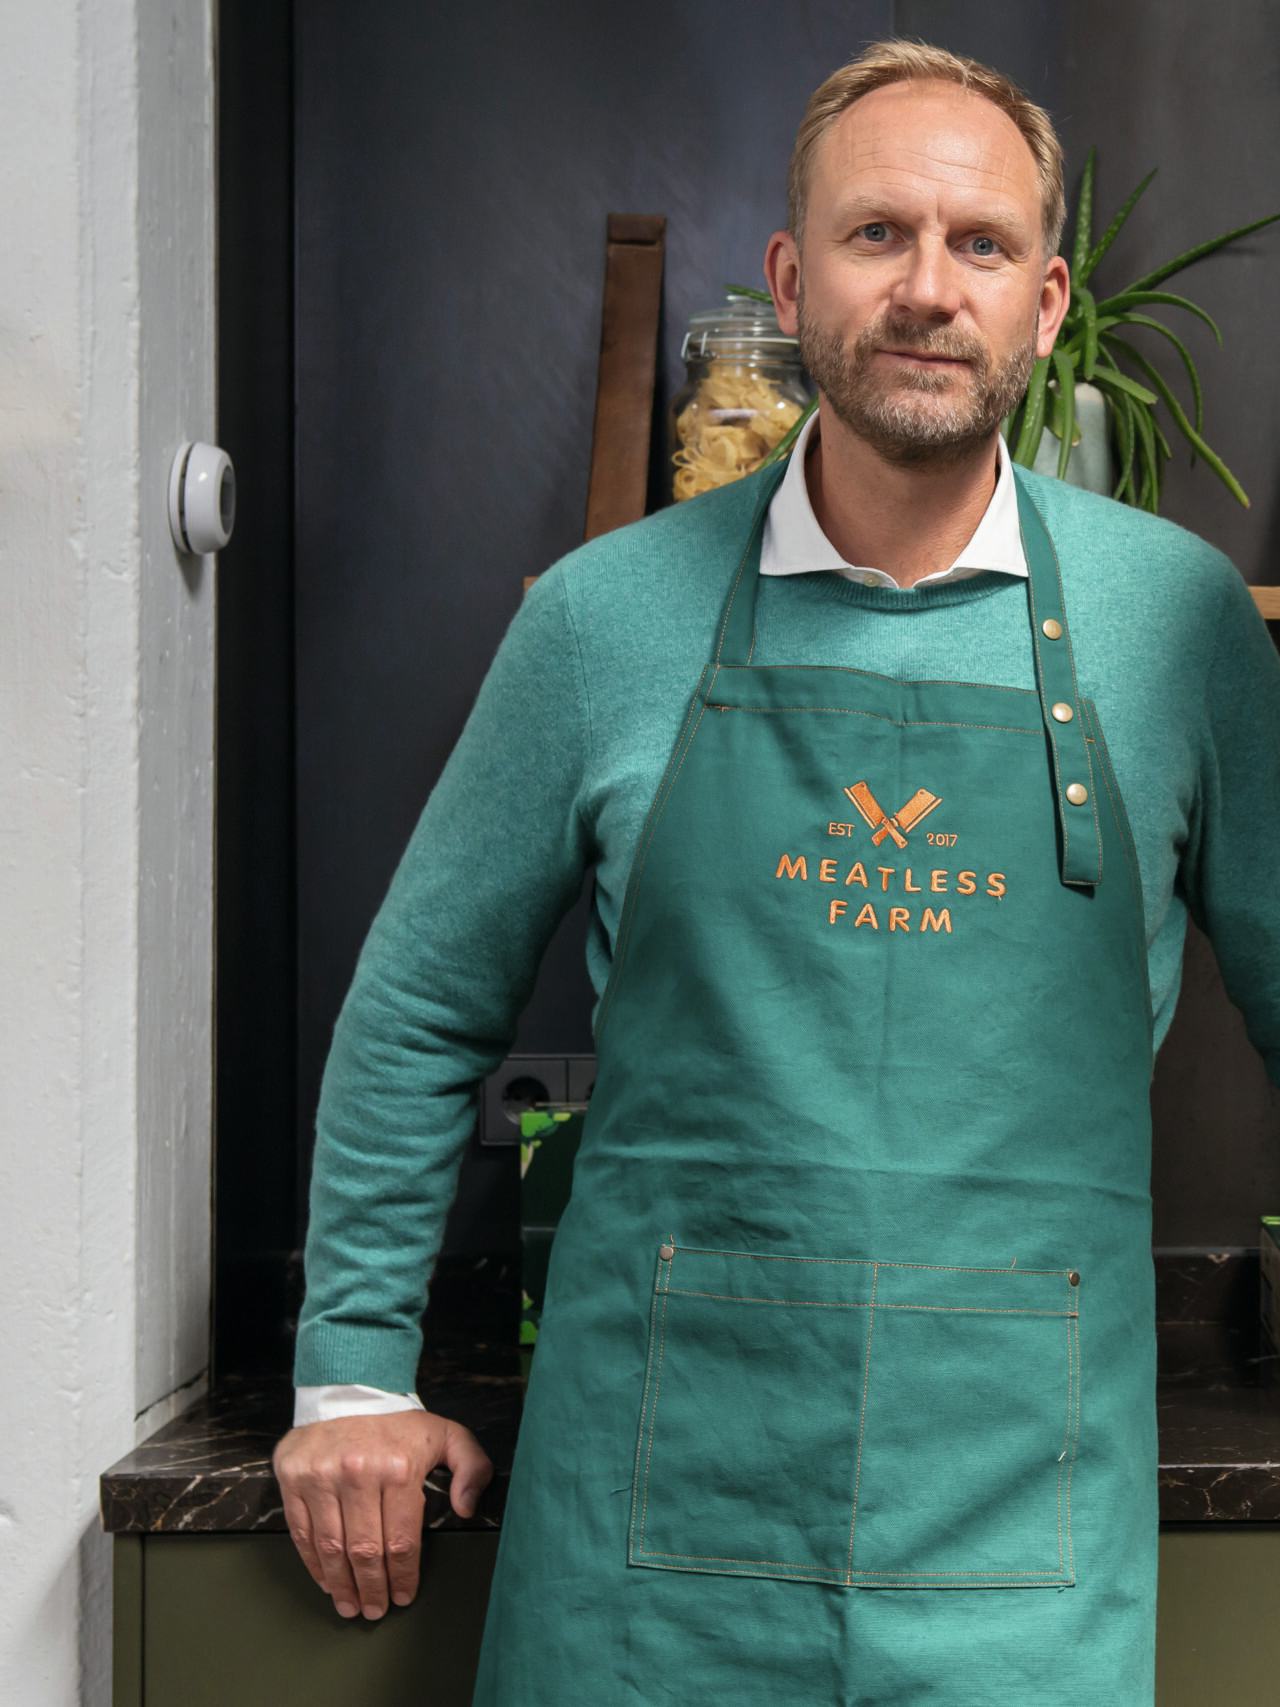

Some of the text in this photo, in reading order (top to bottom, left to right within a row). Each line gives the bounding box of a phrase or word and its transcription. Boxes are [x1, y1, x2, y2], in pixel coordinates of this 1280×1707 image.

[828, 822, 958, 847] EST 2017
[775, 854, 1006, 897] MEATLESS
[829, 900, 952, 932] FARM
